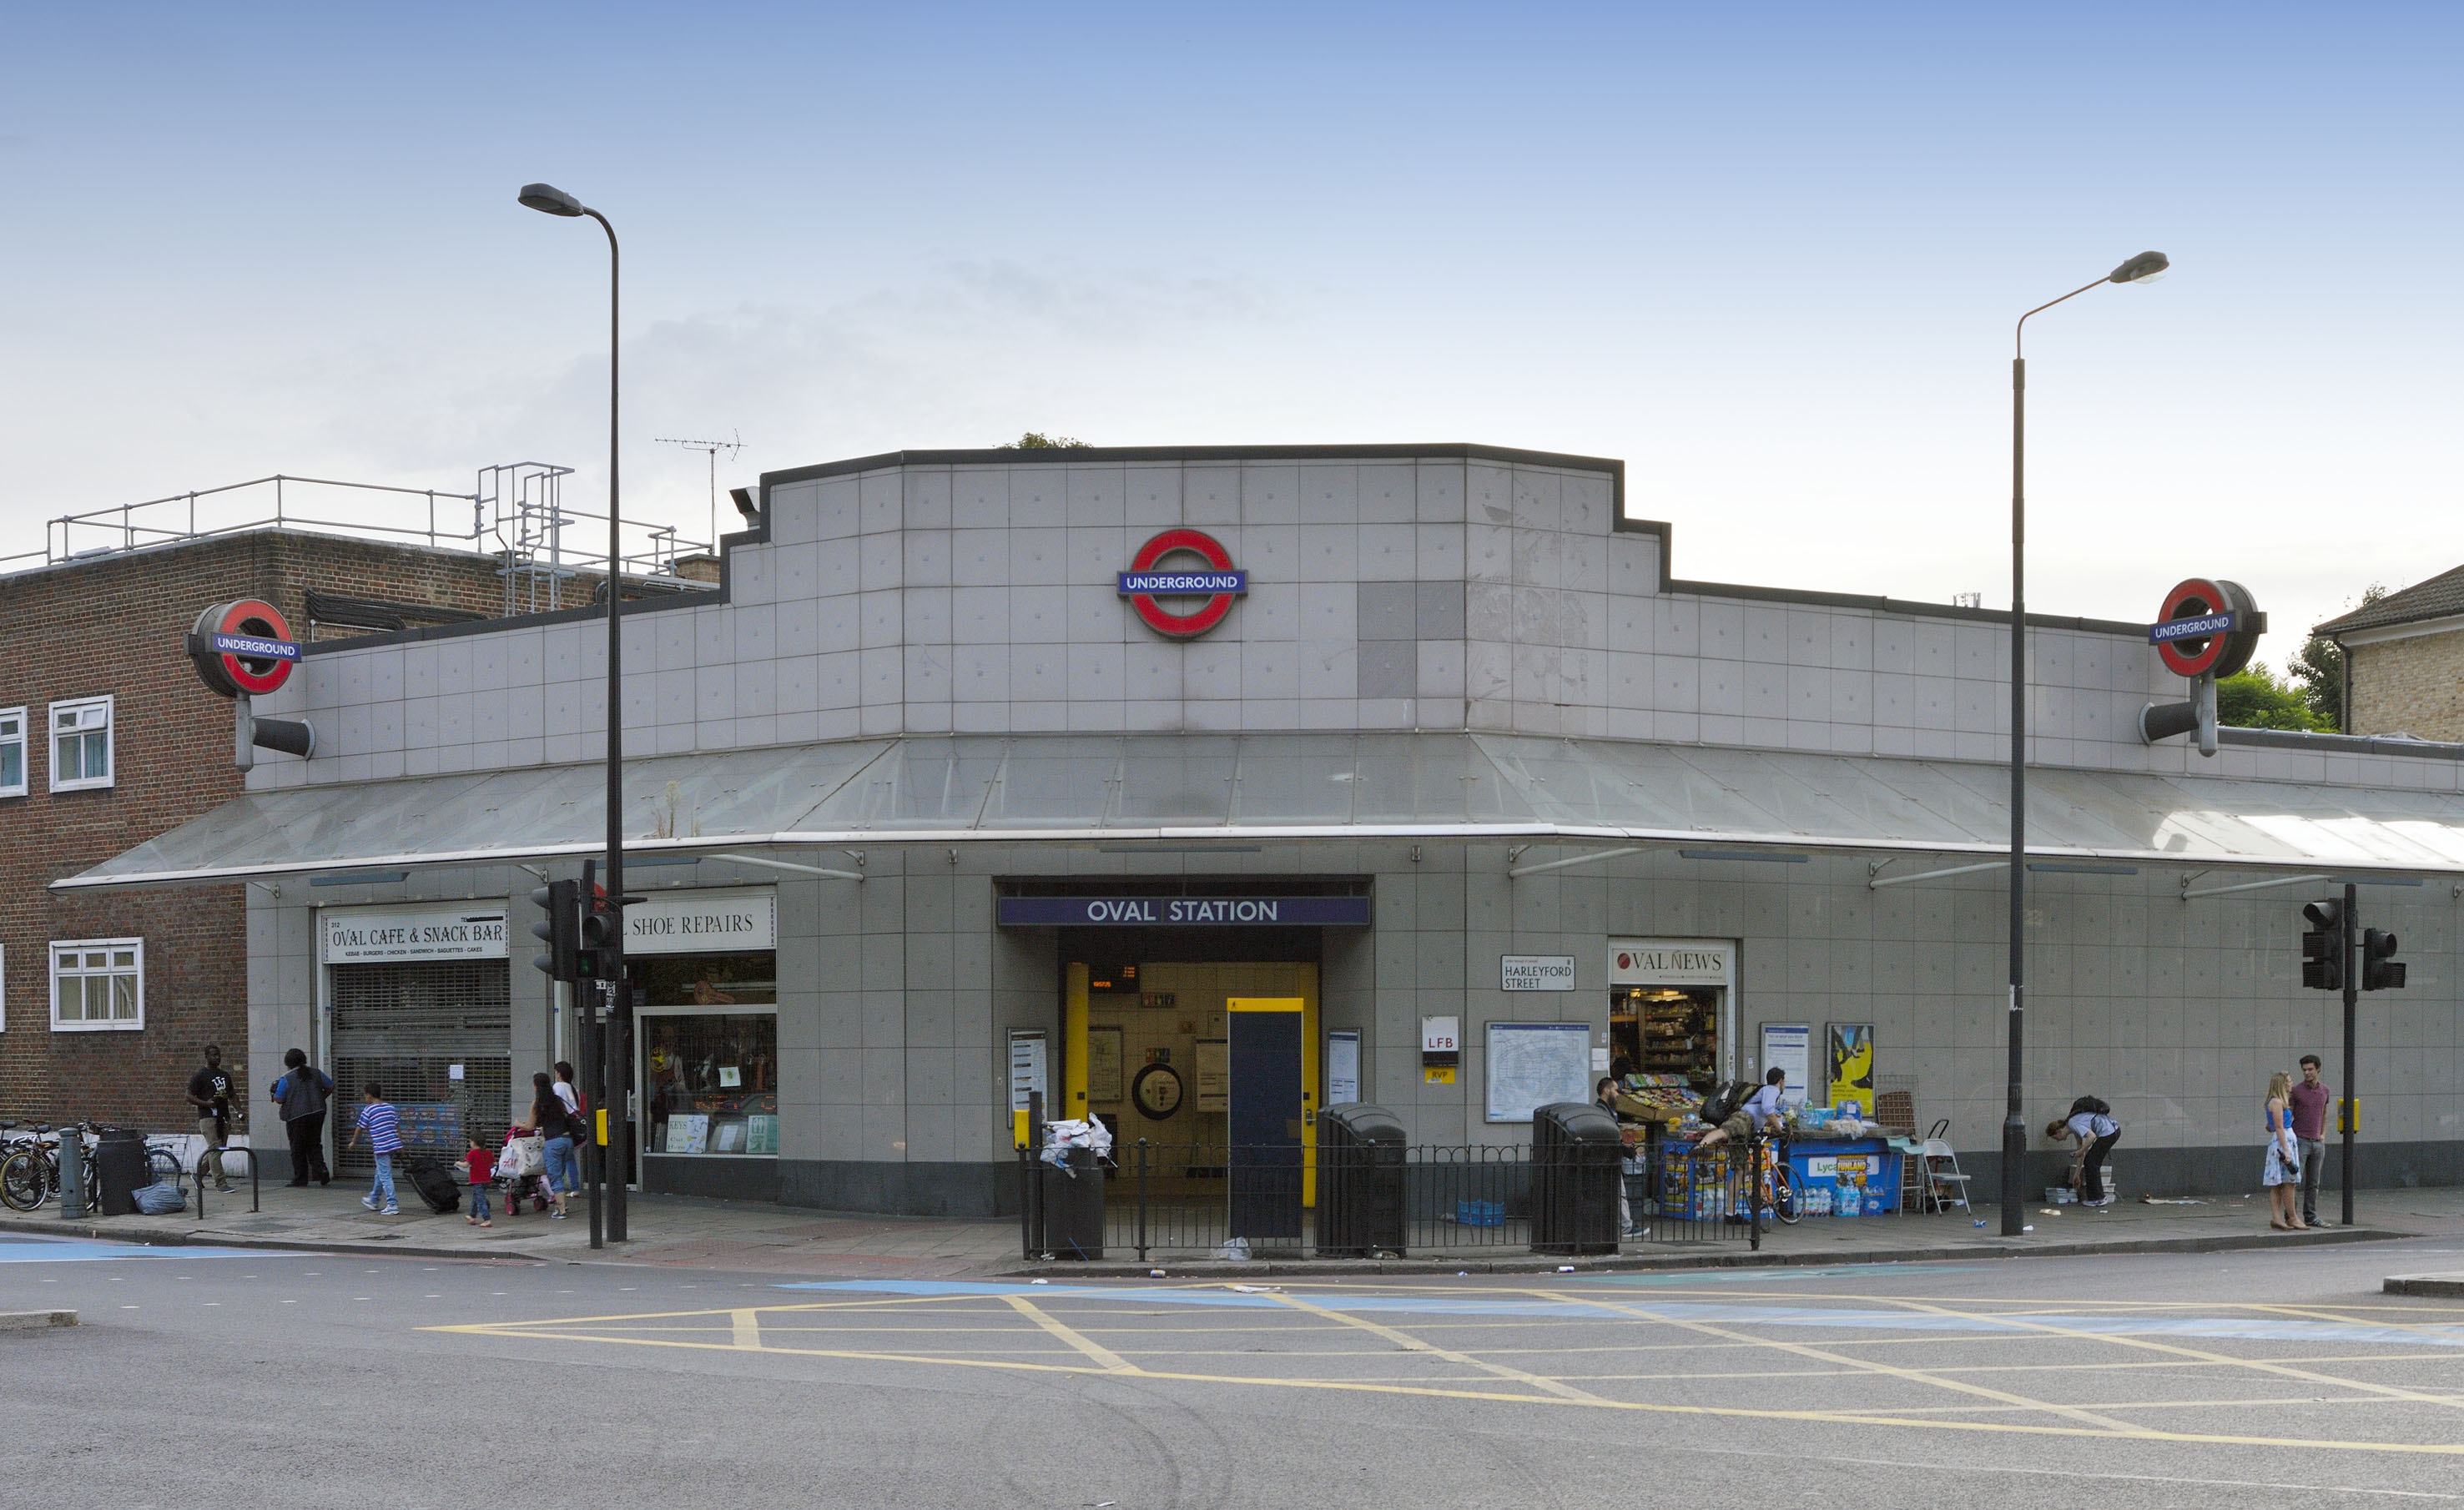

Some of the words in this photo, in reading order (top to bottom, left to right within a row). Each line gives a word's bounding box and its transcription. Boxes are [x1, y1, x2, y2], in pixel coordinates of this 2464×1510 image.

[1126, 576, 1237, 589] UNDERGROUND
[2155, 617, 2229, 638] UNDERGROUND
[218, 637, 295, 656] UNDERGROUND
[1087, 901, 1156, 921] OVAL
[1169, 901, 1277, 921] STATION
[632, 918, 675, 936] SHOE
[682, 914, 753, 934] REPAIRS
[333, 929, 367, 946] OVAL
[370, 929, 405, 945] CAFE
[410, 927, 420, 943] &
[423, 925, 468, 942] SNACK
[473, 924, 502, 941] BAR
[1671, 953, 1721, 971] NEWS
[1504, 966, 1572, 977] HARLEYFORD
[1504, 978, 1541, 989] STREET
[1429, 1037, 1454, 1048] LFB
[669, 1120, 688, 1130] KEYS
[1837, 1160, 1867, 1171] FUNLAND
